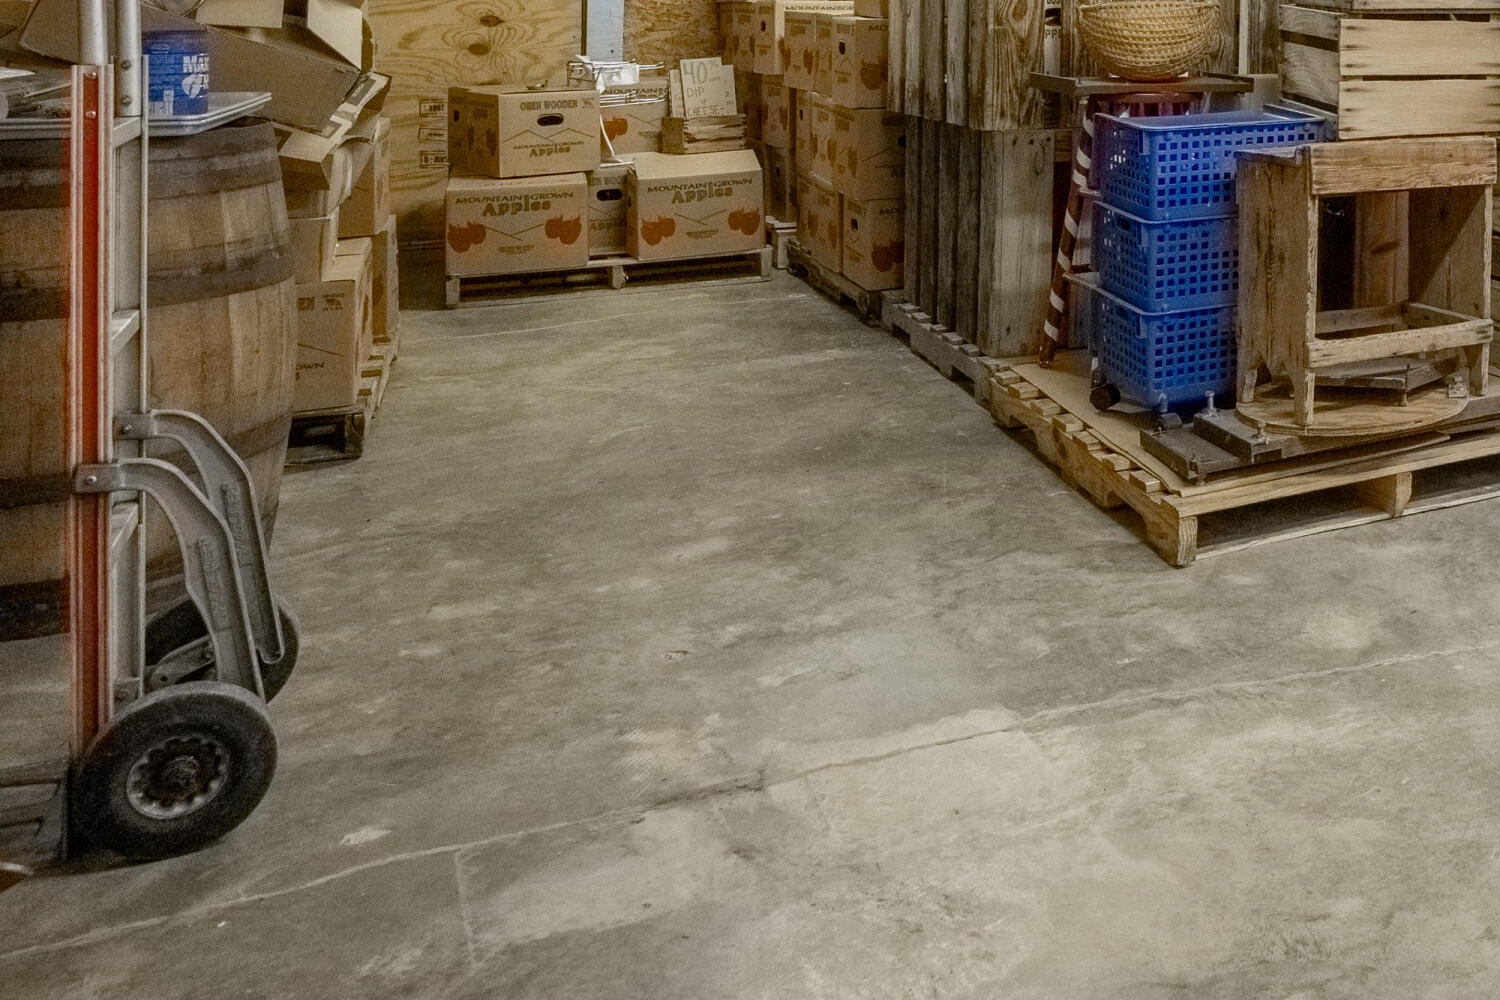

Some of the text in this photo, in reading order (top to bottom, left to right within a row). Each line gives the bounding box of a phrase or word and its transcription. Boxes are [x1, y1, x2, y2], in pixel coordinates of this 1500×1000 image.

[686, 86, 705, 98] DIP
[529, 143, 571, 157] Apples
[647, 178, 753, 193] MOUNTAIN GROWN
[455, 191, 574, 205] MOUNTAIN GROWN
[671, 182, 733, 205] Apples
[482, 194, 552, 217] Apples
